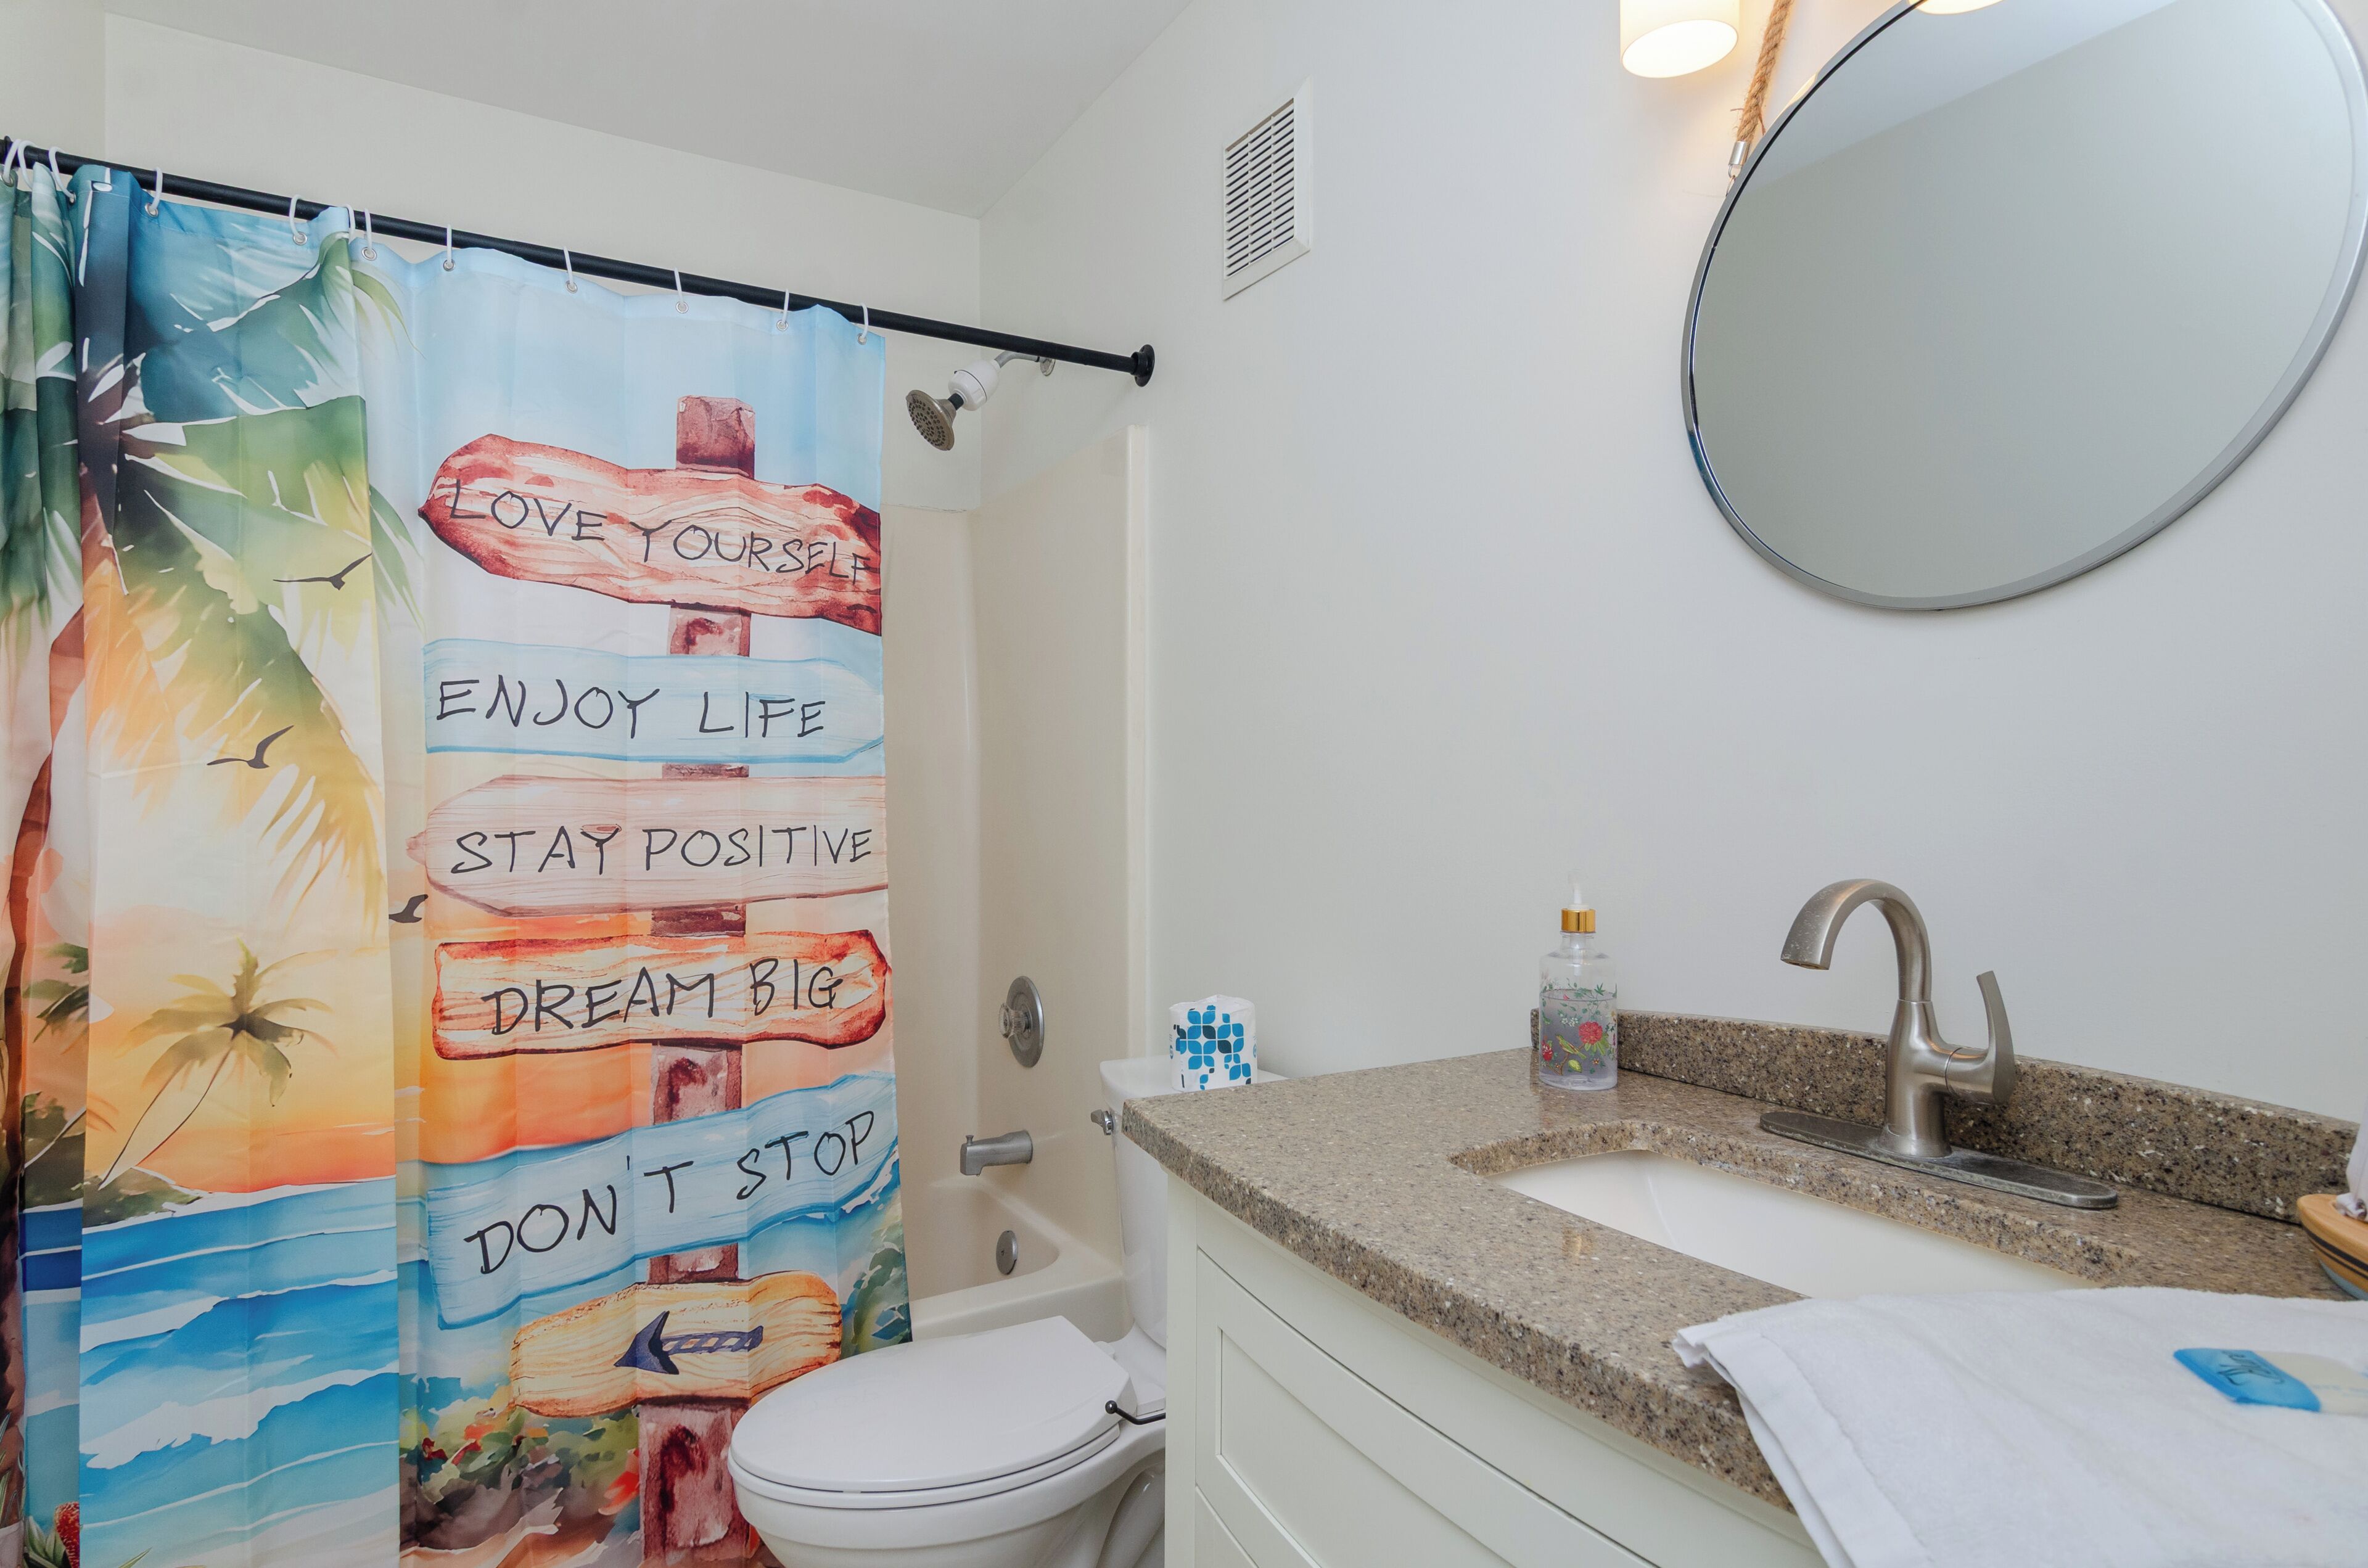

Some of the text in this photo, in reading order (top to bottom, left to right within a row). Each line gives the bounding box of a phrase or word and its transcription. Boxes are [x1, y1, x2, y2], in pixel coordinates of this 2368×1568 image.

[450, 479, 871, 585] LOVE YOURSELF
[437, 675, 826, 739] ENJOY LIFE
[451, 825, 872, 876] STAY POSITIVE
[481, 958, 844, 1036] DREAM BIG
[736, 1110, 875, 1201] STOP
